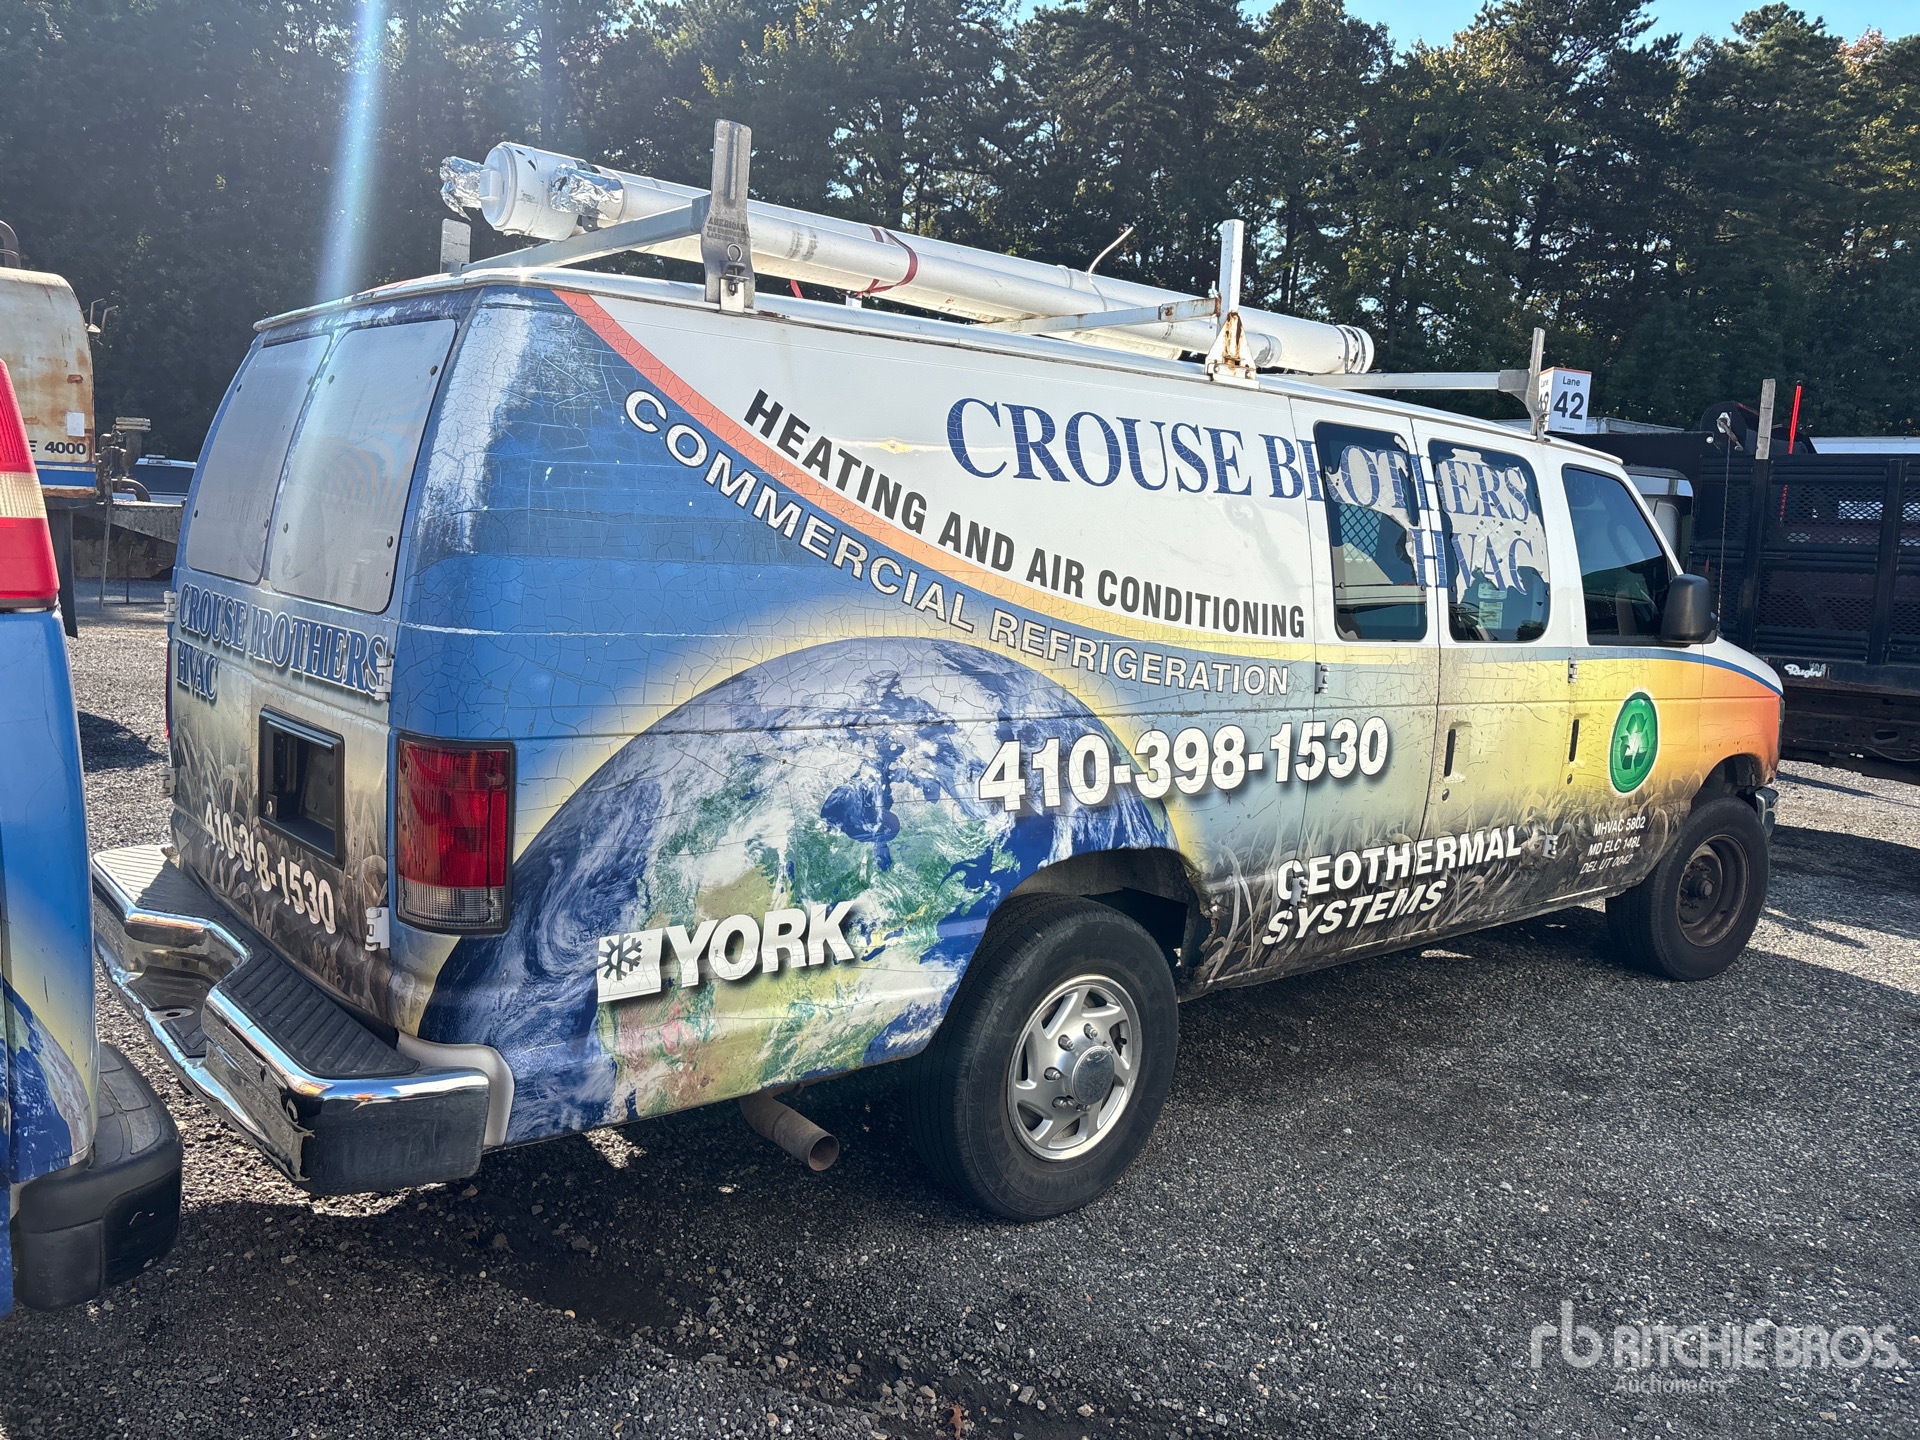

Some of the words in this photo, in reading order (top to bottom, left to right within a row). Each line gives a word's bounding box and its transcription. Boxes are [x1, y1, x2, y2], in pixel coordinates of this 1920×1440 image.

[1553, 391, 1584, 420] 42
[1562, 376, 1581, 387] Lane
[44, 441, 87, 455] 4000
[946, 397, 1252, 497] CROUSE
[624, 389, 974, 634] COMMERCIAL
[989, 608, 1289, 695] REFRIGERATION
[744, 389, 927, 534] HEATING
[938, 511, 1014, 572] AND
[1026, 548, 1085, 598] AIR
[1098, 570, 1305, 638] CONDITIONING
[1409, 528, 1534, 596] HVAC
[177, 638, 219, 701] HVAC
[179, 582, 248, 651] CROUSE
[249, 604, 388, 697] ROTHERS
[978, 716, 1390, 812] 410-398-1530
[1587, 842, 1603, 857] MD
[1602, 838, 1622, 854] ELC
[1593, 819, 1625, 837] MHVAC
[1625, 815, 1646, 831] 5802
[1277, 824, 1522, 901] GEOTHERMAL
[1579, 860, 1598, 875] DEL
[1598, 857, 1614, 870] UT
[1611, 853, 1634, 868] 0042
[665, 900, 858, 988] YORK
[1261, 880, 1447, 945] SYSTEMS
